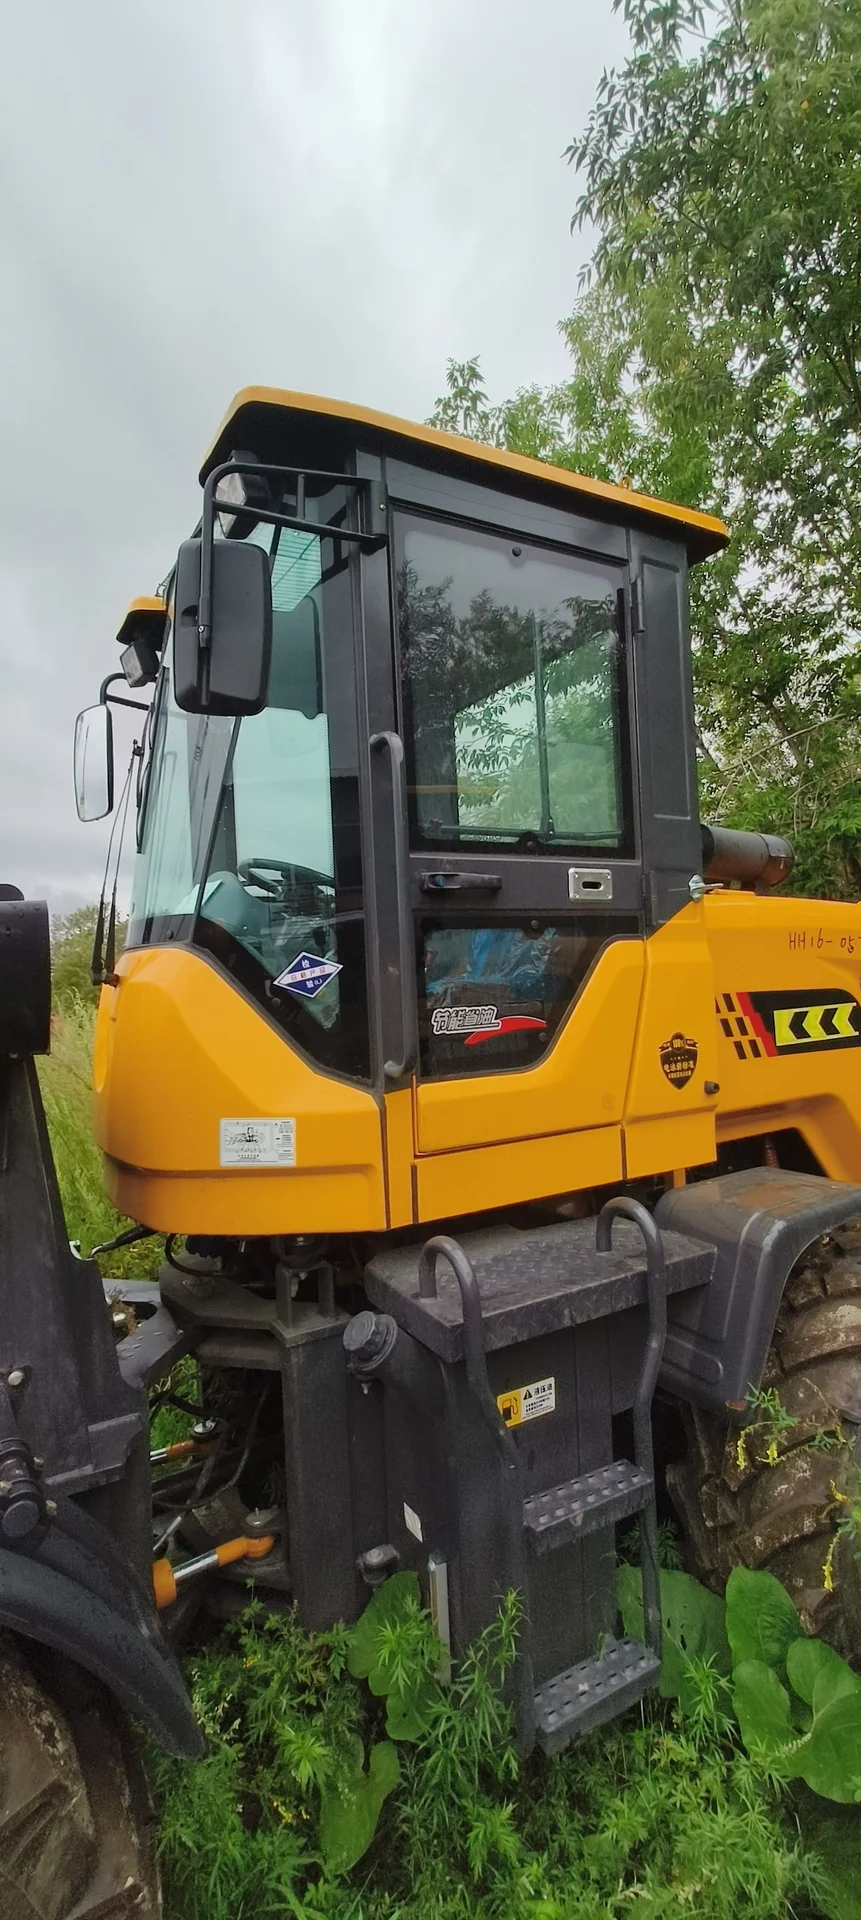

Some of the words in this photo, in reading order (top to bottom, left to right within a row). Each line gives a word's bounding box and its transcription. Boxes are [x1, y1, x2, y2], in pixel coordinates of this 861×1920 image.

[435, 1009, 493, 1031] 节能省油
[534, 1383, 552, 1396] 液压油
